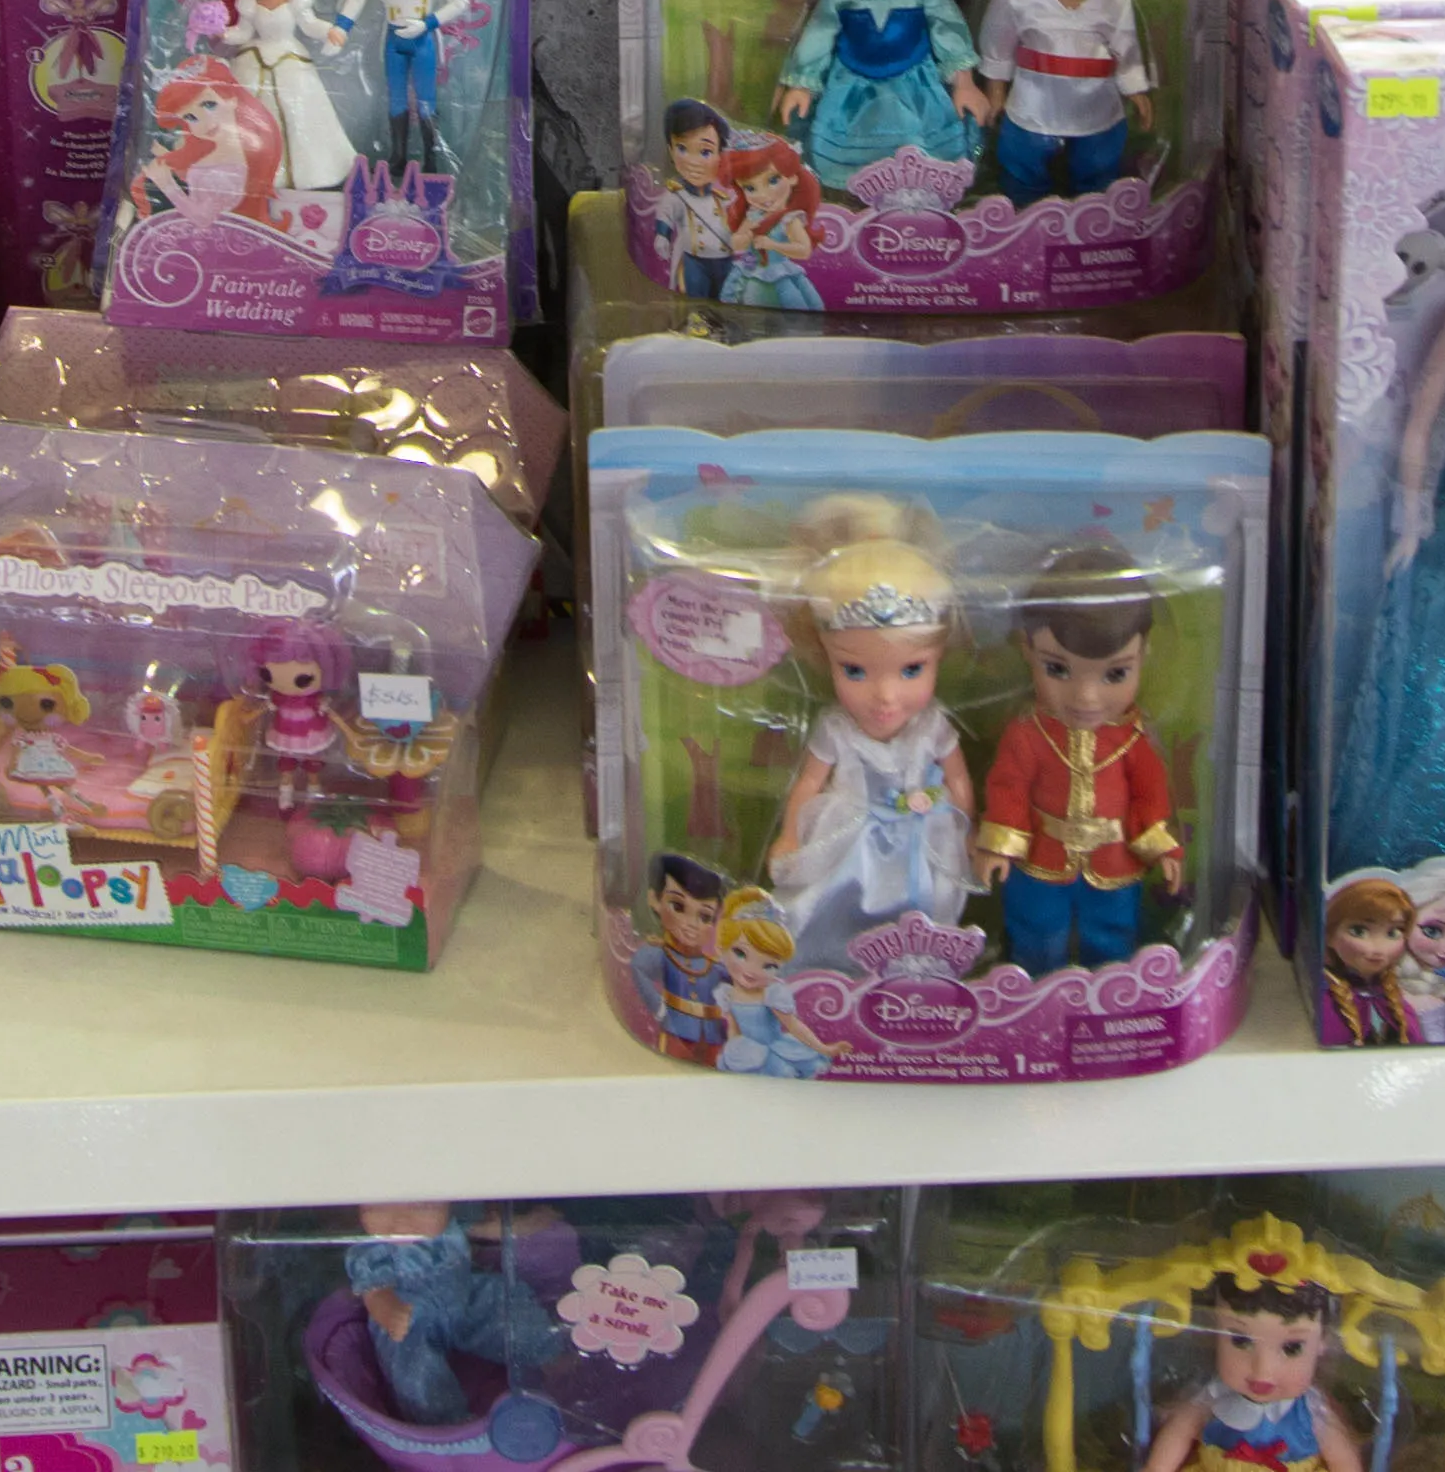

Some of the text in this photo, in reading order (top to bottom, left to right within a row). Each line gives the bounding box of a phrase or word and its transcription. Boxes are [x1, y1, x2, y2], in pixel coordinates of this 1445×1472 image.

[899, 154, 967, 200] first
[209, 273, 307, 301] Fairytale
[478, 278, 498, 292] 3+
[999, 282, 1011, 303] 1
[868, 294, 905, 306] Prince
[205, 298, 296, 327] Wedding
[857, 918, 978, 966] my first
[878, 1051, 934, 1064] Princess
[1014, 1053, 1026, 1075] 1
[855, 1064, 896, 1076] Prince
[897, 1065, 959, 1079] Charming
[960, 1065, 985, 1077] Gift
[987, 1066, 1010, 1077] Set
[598, 1279, 669, 1311] Take me
[613, 1301, 640, 1318] for
[588, 1314, 600, 1324] a
[45, 1379, 71, 1390] Small
[13, 1394, 46, 1405] under
[39, 1406, 54, 1418] DE
